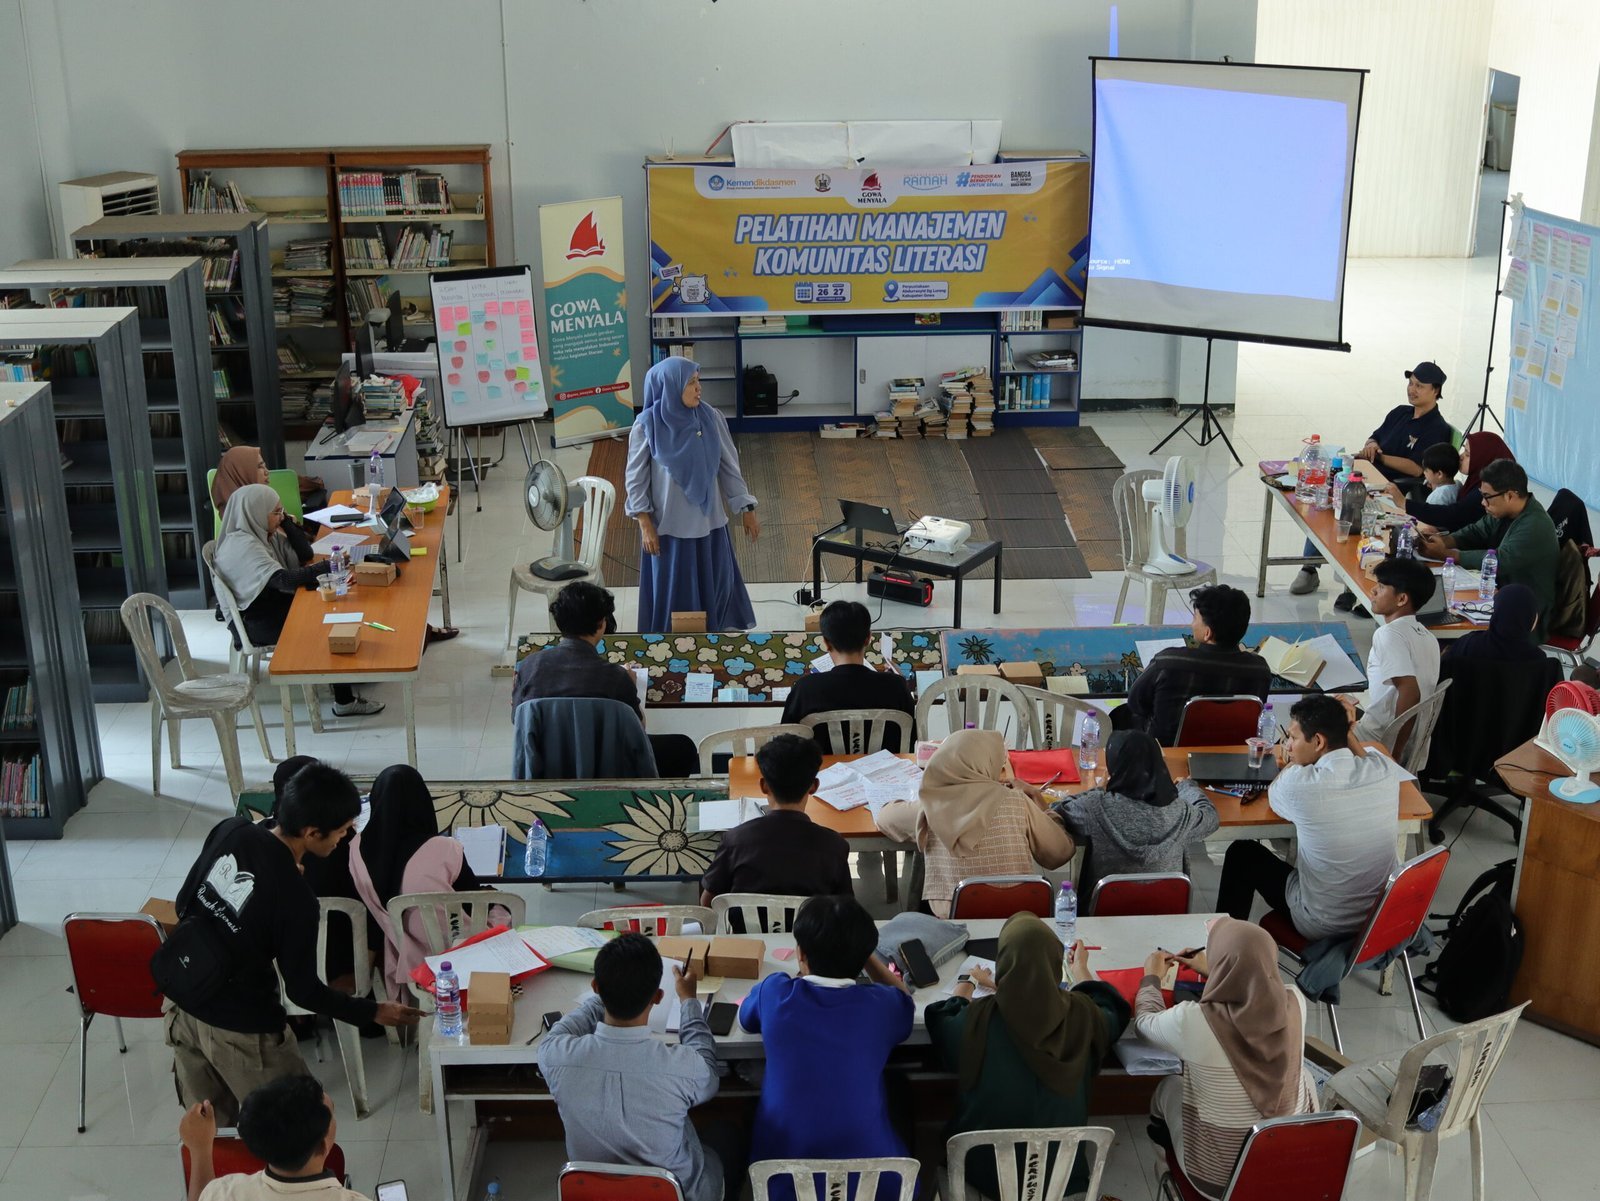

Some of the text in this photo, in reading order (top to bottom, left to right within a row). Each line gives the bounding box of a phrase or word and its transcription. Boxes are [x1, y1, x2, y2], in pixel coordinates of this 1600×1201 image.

[726, 178, 797, 187] Kemendikdasmen
[903, 176, 948, 186] RAMAH
[735, 211, 1006, 243] PELATIHAN MANAJEMEN
[754, 244, 987, 276] KOMUNITAS LITERASI
[817, 288, 845, 296] 26 27
[550, 298, 601, 318] GOWA
[550, 310, 624, 334] MENYALA
